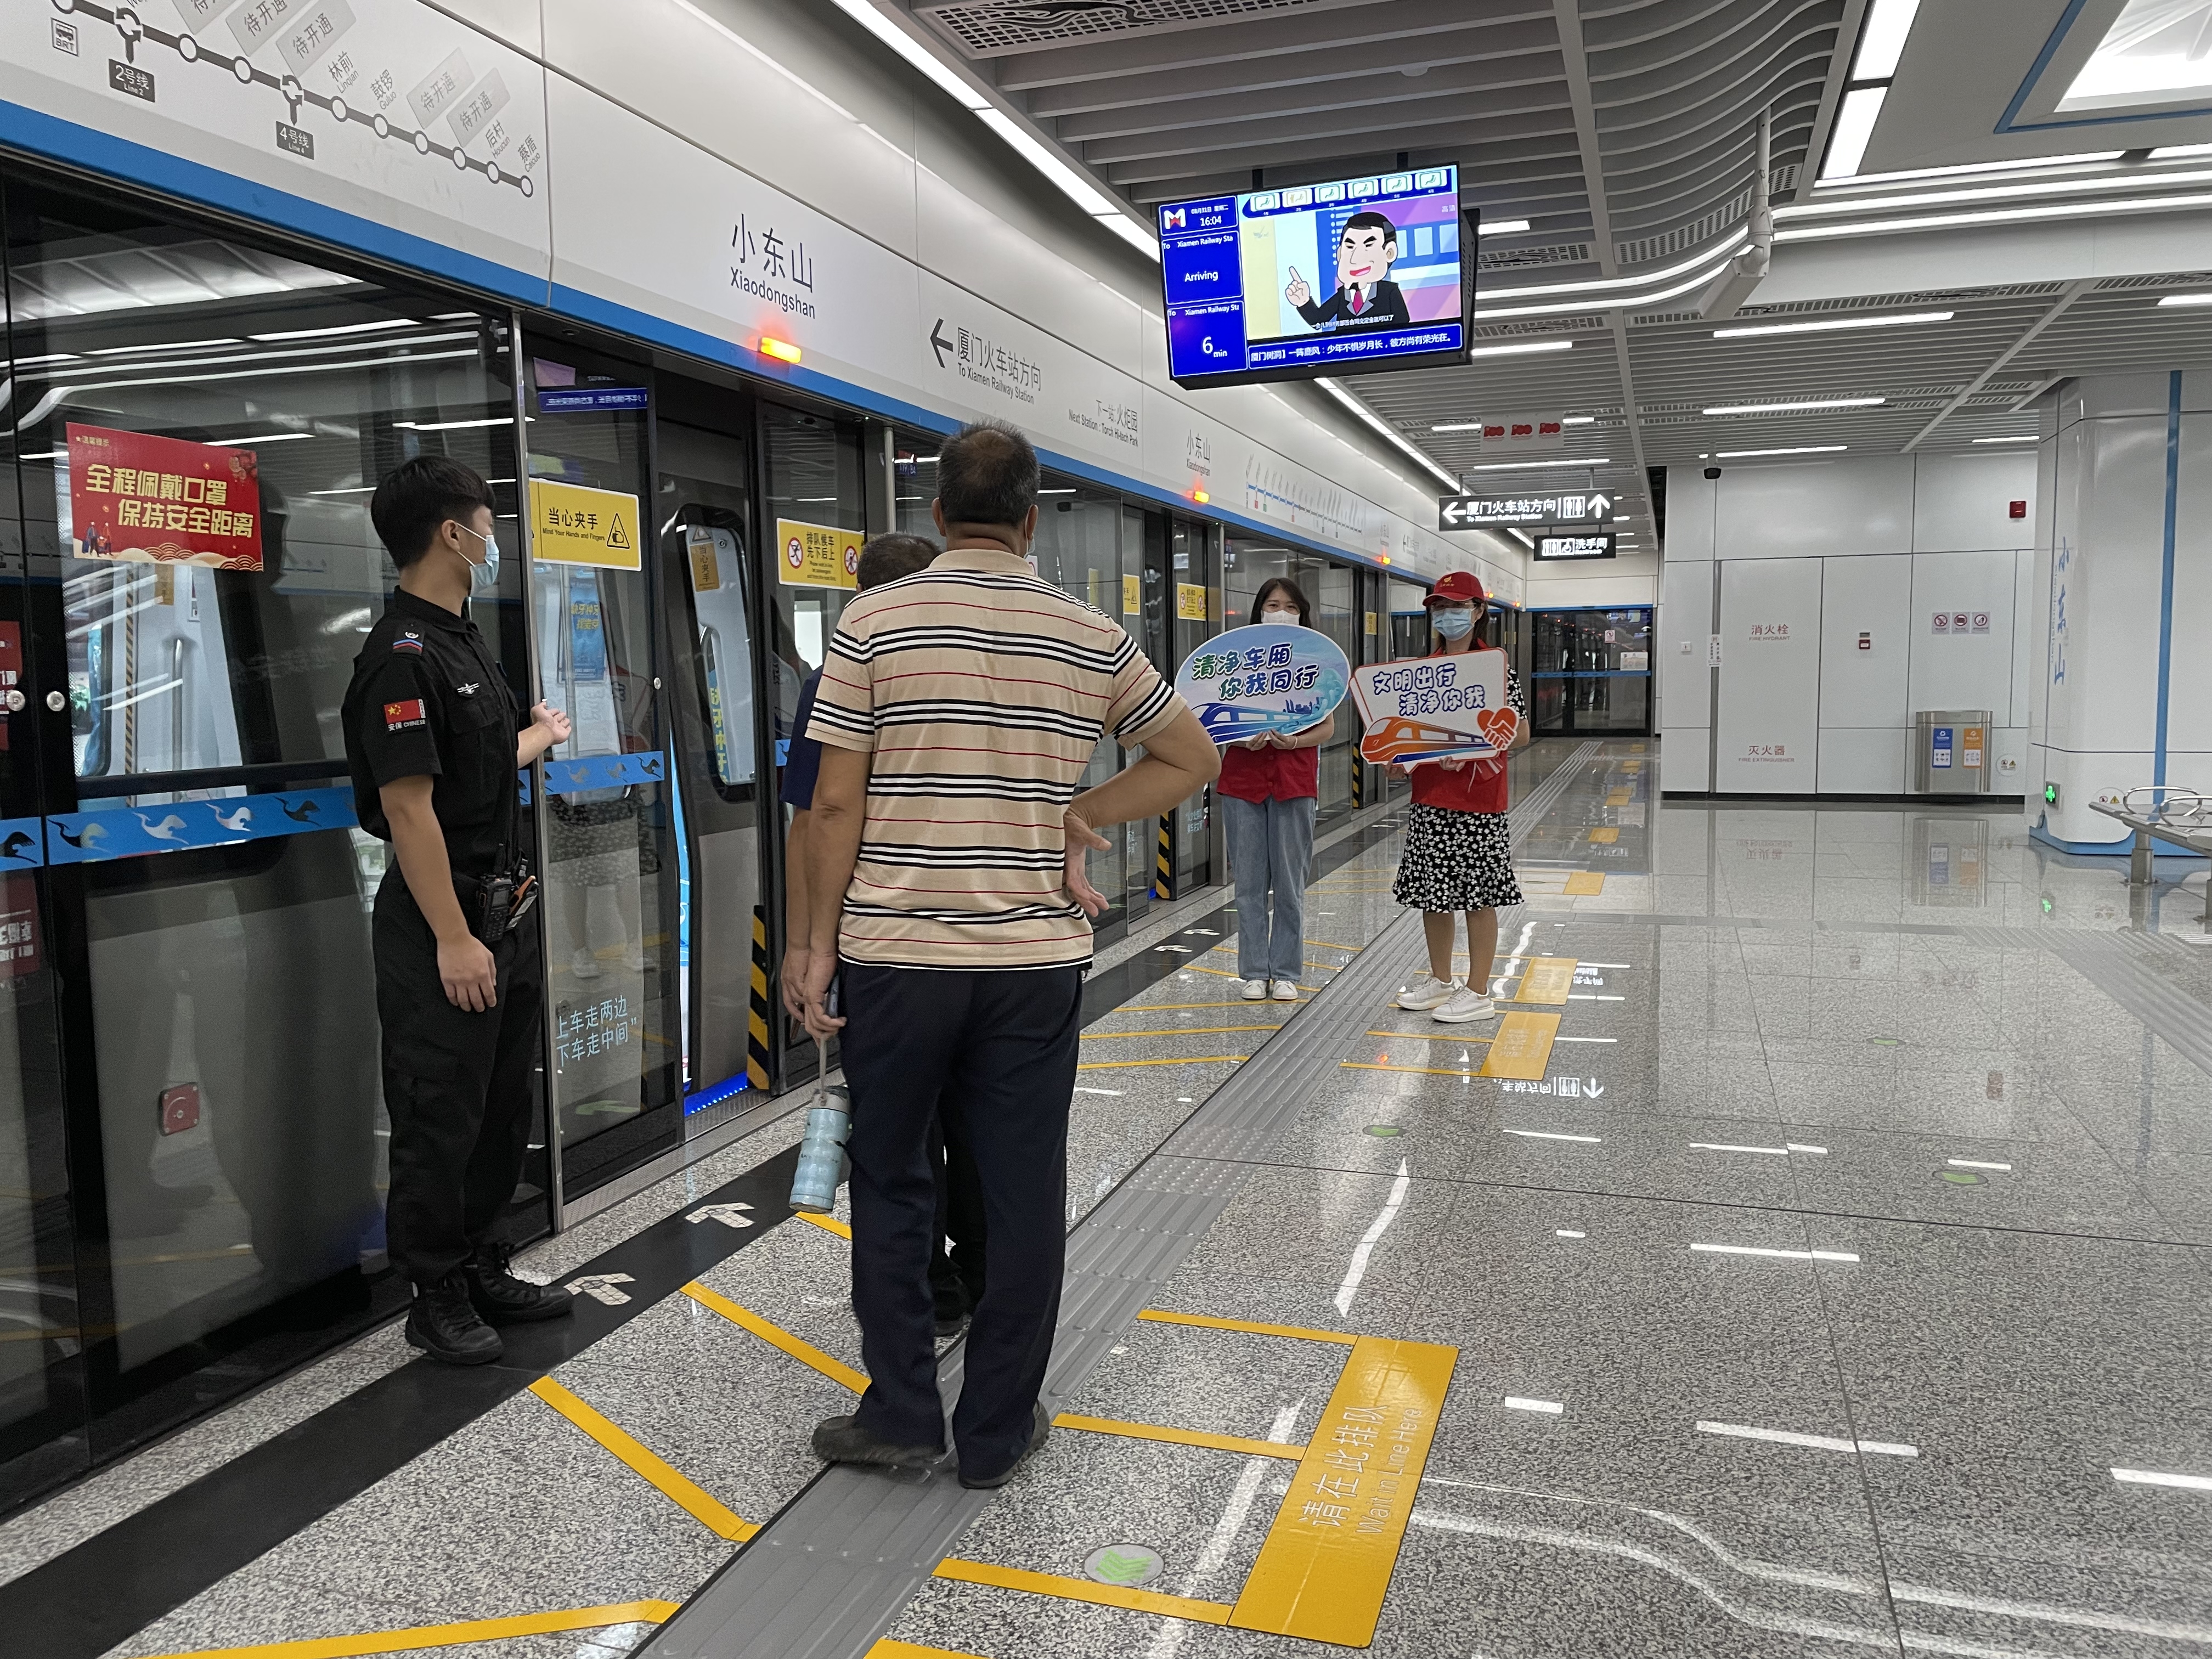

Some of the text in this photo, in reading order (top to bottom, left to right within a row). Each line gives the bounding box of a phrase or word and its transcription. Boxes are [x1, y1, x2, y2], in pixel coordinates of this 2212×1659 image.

[55, 38, 75, 52] BRT
[293, 12, 334, 59] 待开通
[115, 65, 149, 90] 2号线
[328, 50, 353, 82] 林前
[123, 82, 138, 95] Line
[336, 70, 359, 94] Linqian
[421, 71, 456, 112] 待开通
[460, 91, 492, 131] 待开通
[280, 127, 309, 148] 4号线
[289, 142, 301, 153] Line
[485, 119, 504, 148] 后村
[1200, 215, 1222, 226] 16:04
[732, 213, 814, 294] 小东山
[1177, 240, 1200, 248] Xiamen
[1200, 236, 1222, 245] Railway
[1184, 270, 1218, 283] Arriving
[730, 266, 816, 319] Xiaodongshan
[1185, 308, 1207, 316] Xiamen
[1207, 305, 1230, 313] Railway
[957, 326, 1041, 392] 厦门火车站方向
[1203, 336, 1228, 358] 6 min
[958, 362, 1034, 405] To Xiamen Railway Station
[1069, 409, 1081, 425] Next
[1101, 422, 1114, 438] Torch
[1187, 428, 1210, 464] 小东山
[86, 463, 227, 506] 全程佩戴口罩
[117, 499, 254, 538] 保持安全距离
[549, 507, 598, 530] 当心夹手
[1466, 498, 1556, 515] 厦门火车站方向
[1575, 537, 1608, 549] 洗手间
[1751, 624, 1789, 635] 消火栓
[1192, 642, 1293, 680] 清净车厢
[1218, 664, 1319, 701] 你我同行
[1373, 662, 1457, 695] 文明出行
[1399, 685, 1486, 716] 清净你我
[1748, 745, 1785, 756] 灭火器
[556, 994, 628, 1040] 上车走两边
[1299, 1405, 1388, 1528] 请在此排队
[1356, 1408, 1422, 1534] Wait in Line Here
